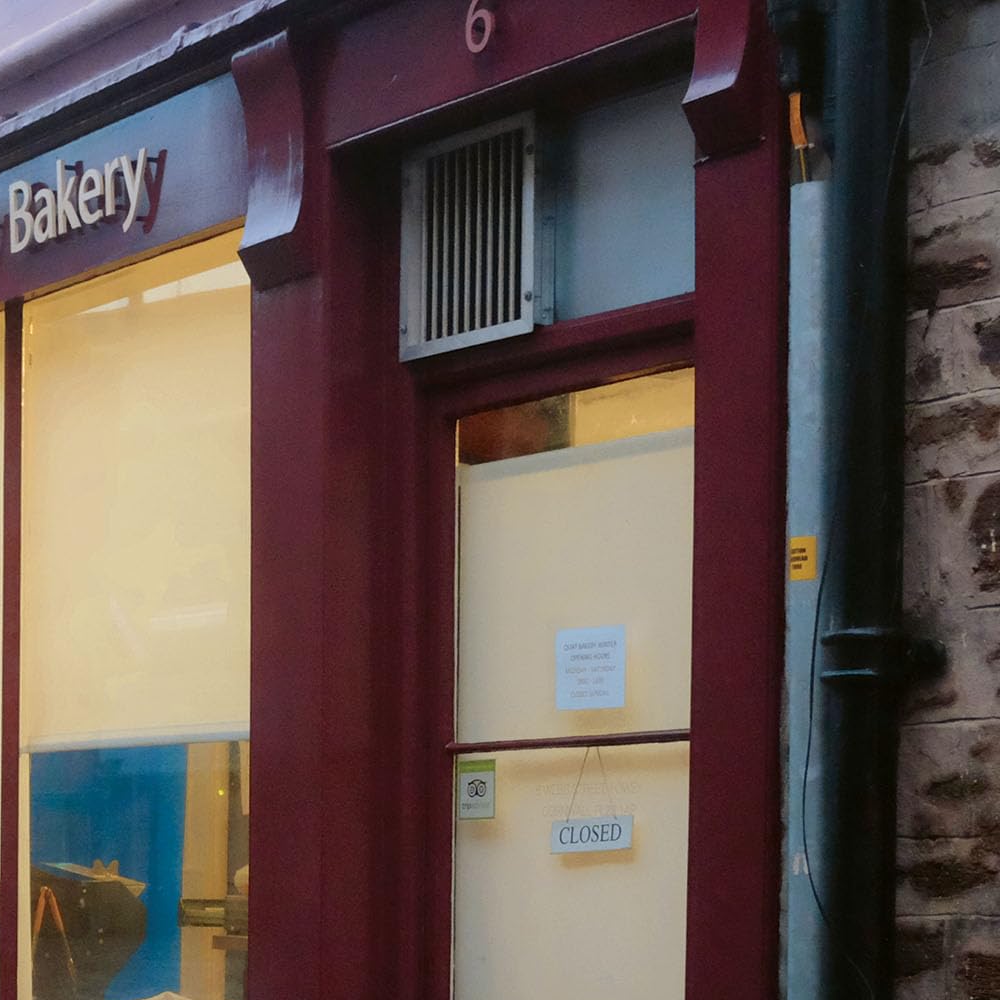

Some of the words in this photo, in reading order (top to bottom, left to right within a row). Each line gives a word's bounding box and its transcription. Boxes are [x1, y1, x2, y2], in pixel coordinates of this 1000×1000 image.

[465, 0, 493, 53] 6
[9, 148, 148, 254] Bakery
[559, 823, 622, 845] CLOSED
